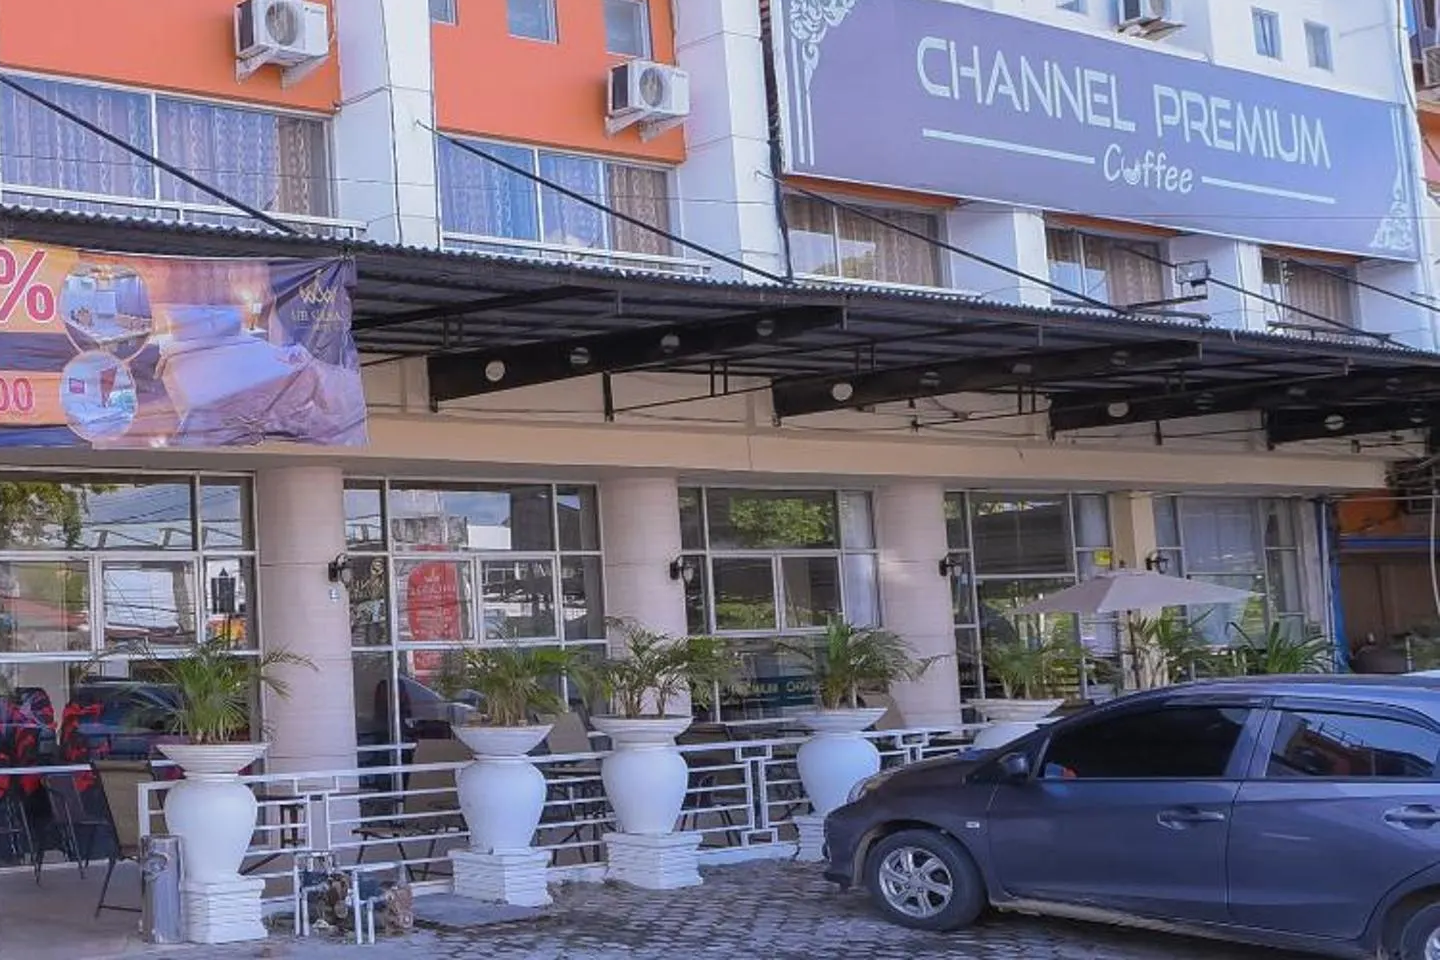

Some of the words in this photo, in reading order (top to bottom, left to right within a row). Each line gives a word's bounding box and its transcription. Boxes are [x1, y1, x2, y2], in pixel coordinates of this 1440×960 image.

[916, 37, 1136, 131] CHANNEL
[1154, 85, 1333, 169] PREMIUM
[1103, 143, 1193, 194] Coffee
